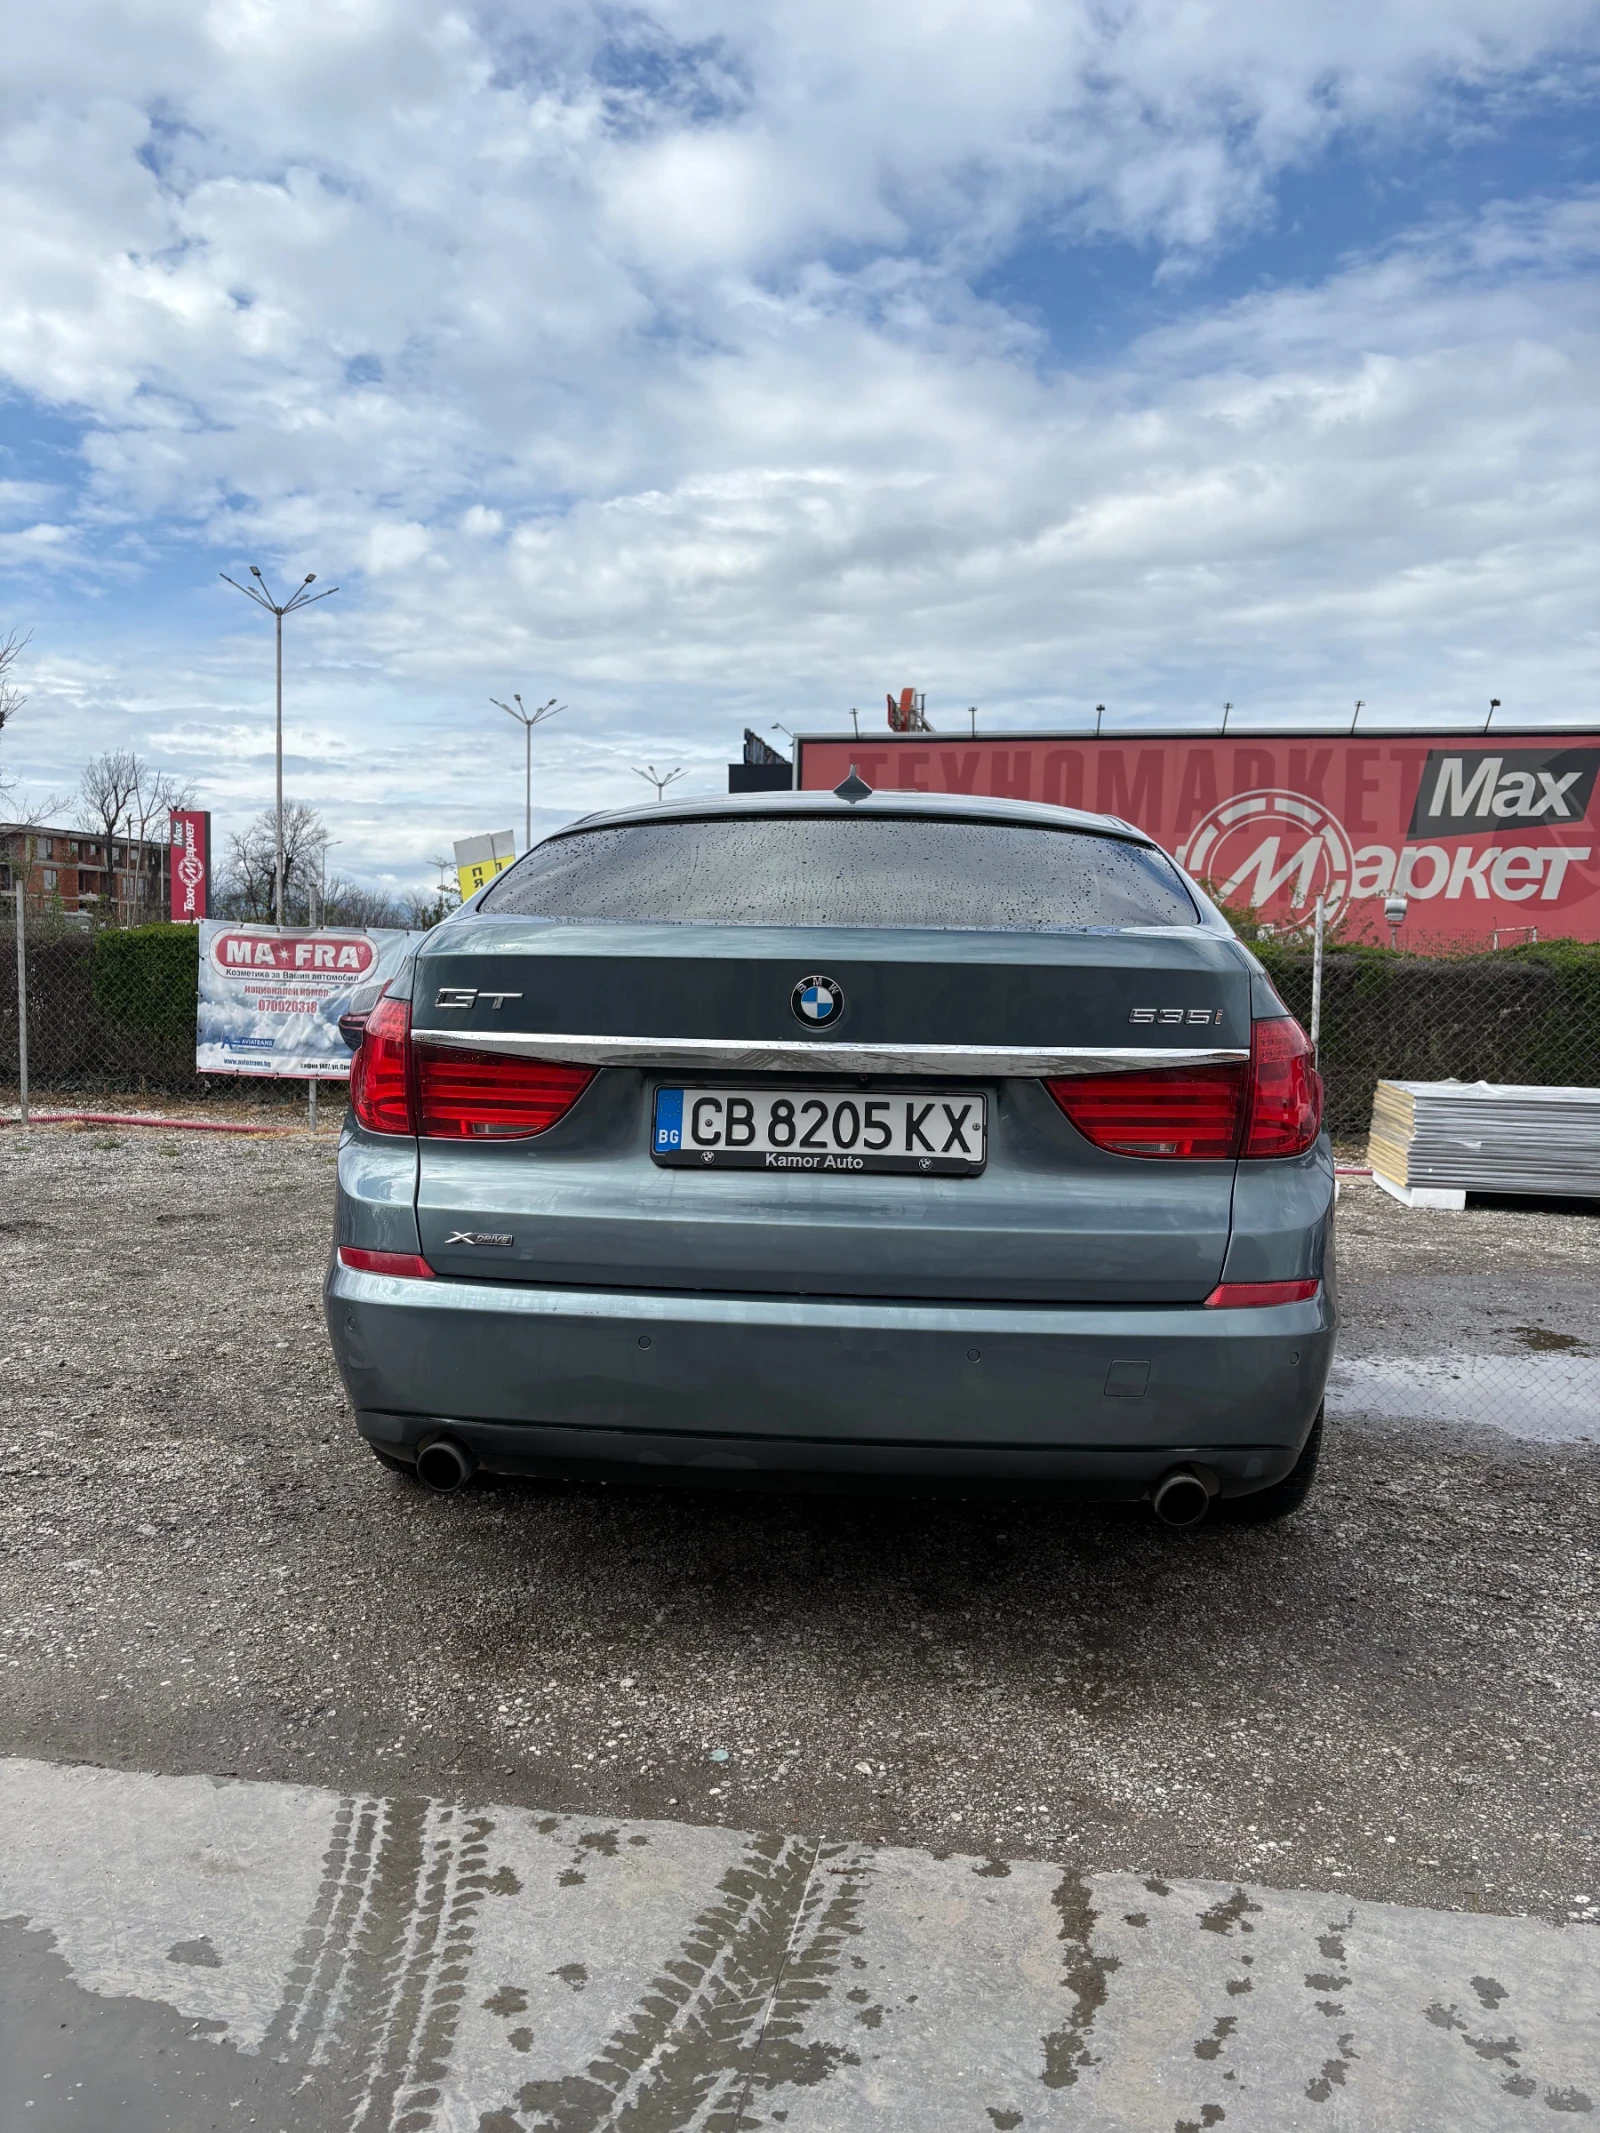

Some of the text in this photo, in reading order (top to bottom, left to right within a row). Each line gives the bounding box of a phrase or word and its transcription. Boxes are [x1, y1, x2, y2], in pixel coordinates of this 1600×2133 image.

[1428, 757, 1583, 818] Max
[173, 822, 183, 846] Max
[226, 969, 270, 979] Козметика
[283, 972, 310, 980] Вашия
[311, 974, 359, 982] автомобил
[244, 985, 299, 997] национален
[435, 988, 524, 1010] GT
[1128, 1008, 1224, 1025] 535i
[691, 1097, 972, 1153] CB 8205 KX
[658, 1129, 679, 1145] BG
[765, 1153, 864, 1169] Kamor Auto
